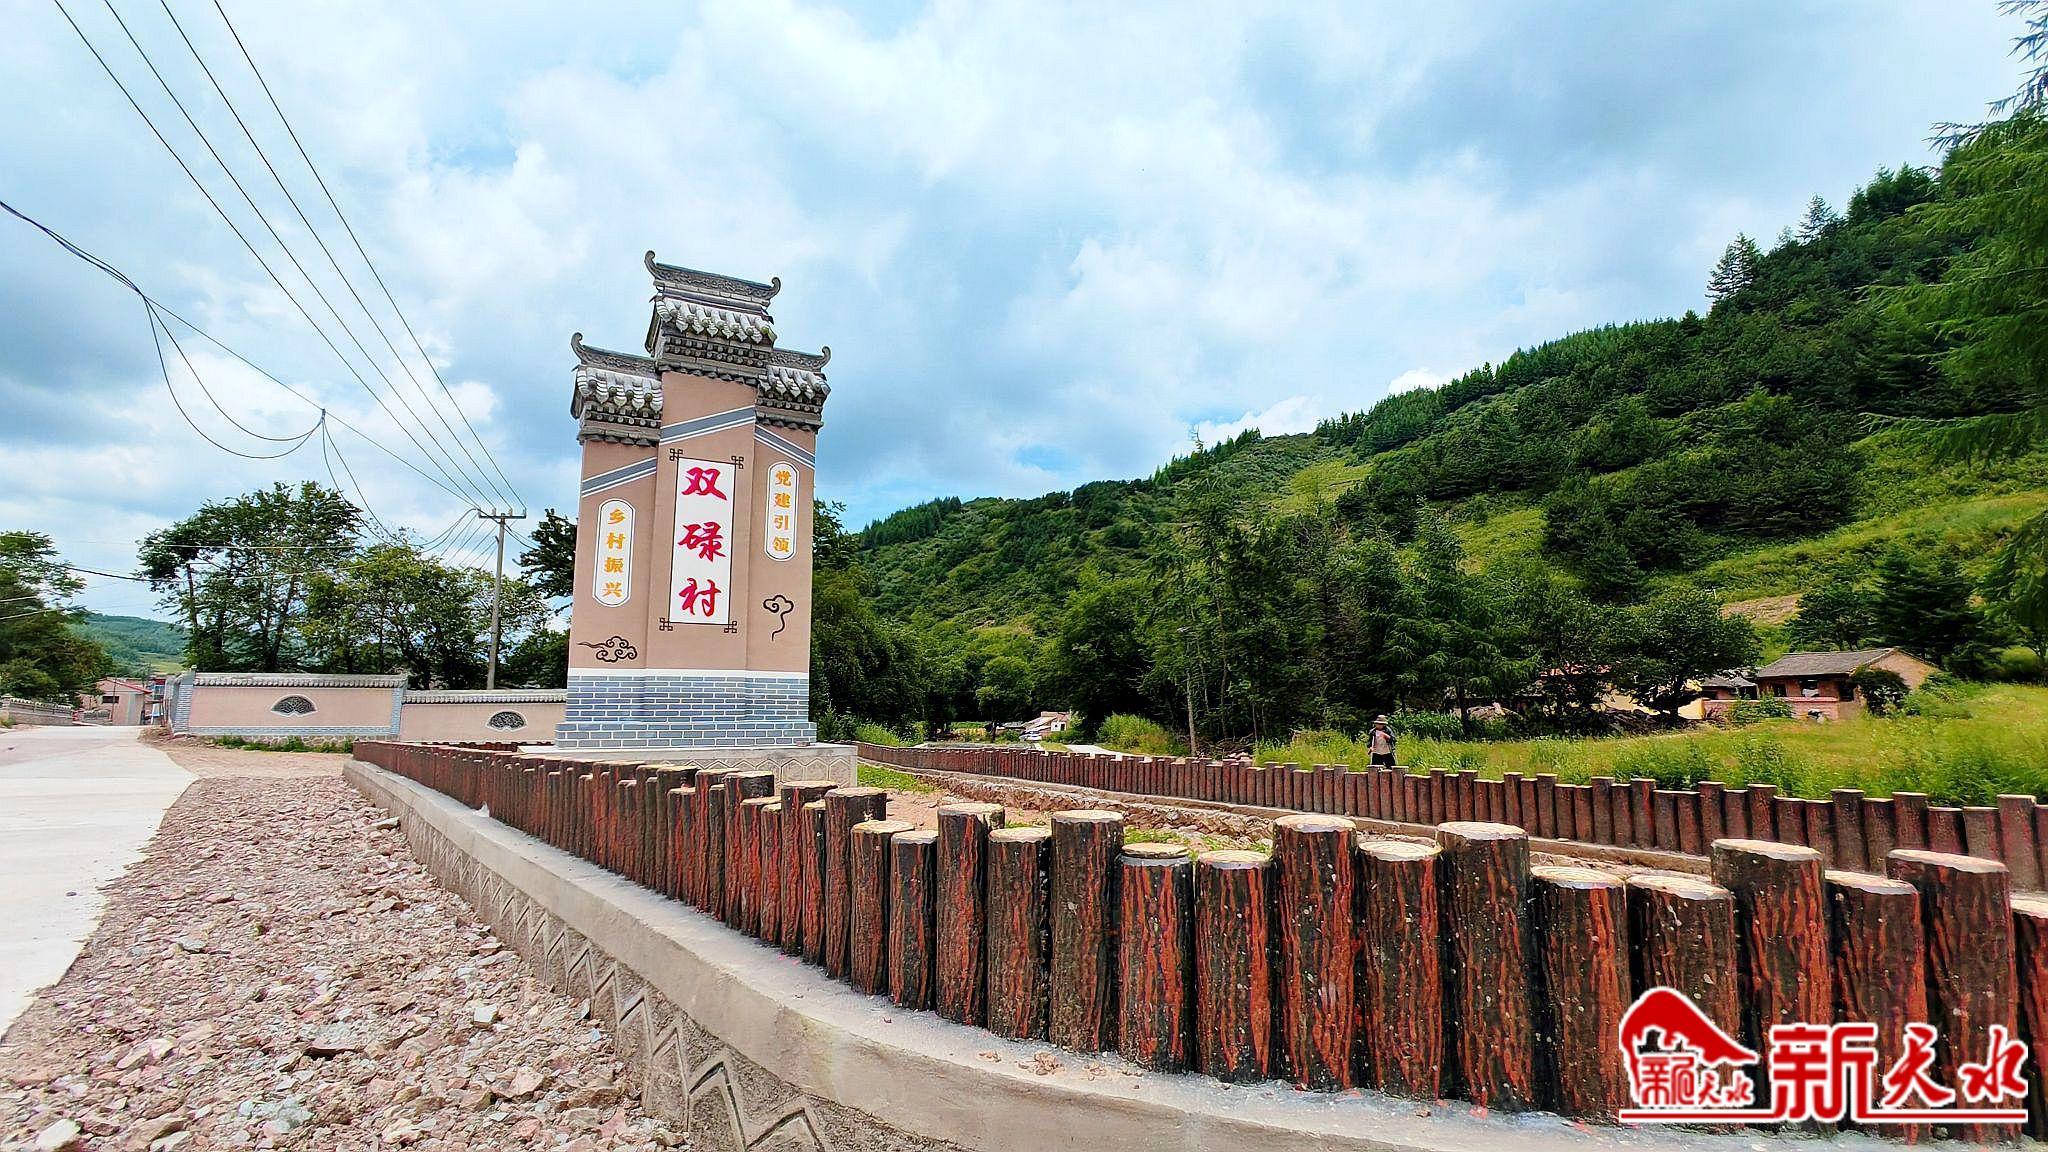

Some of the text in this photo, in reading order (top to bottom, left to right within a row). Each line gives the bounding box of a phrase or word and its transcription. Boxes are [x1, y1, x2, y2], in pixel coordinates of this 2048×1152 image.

[602, 508, 626, 598] 乡村振兴
[678, 466, 728, 618] 双碌村
[772, 470, 792, 553] 党建引领
